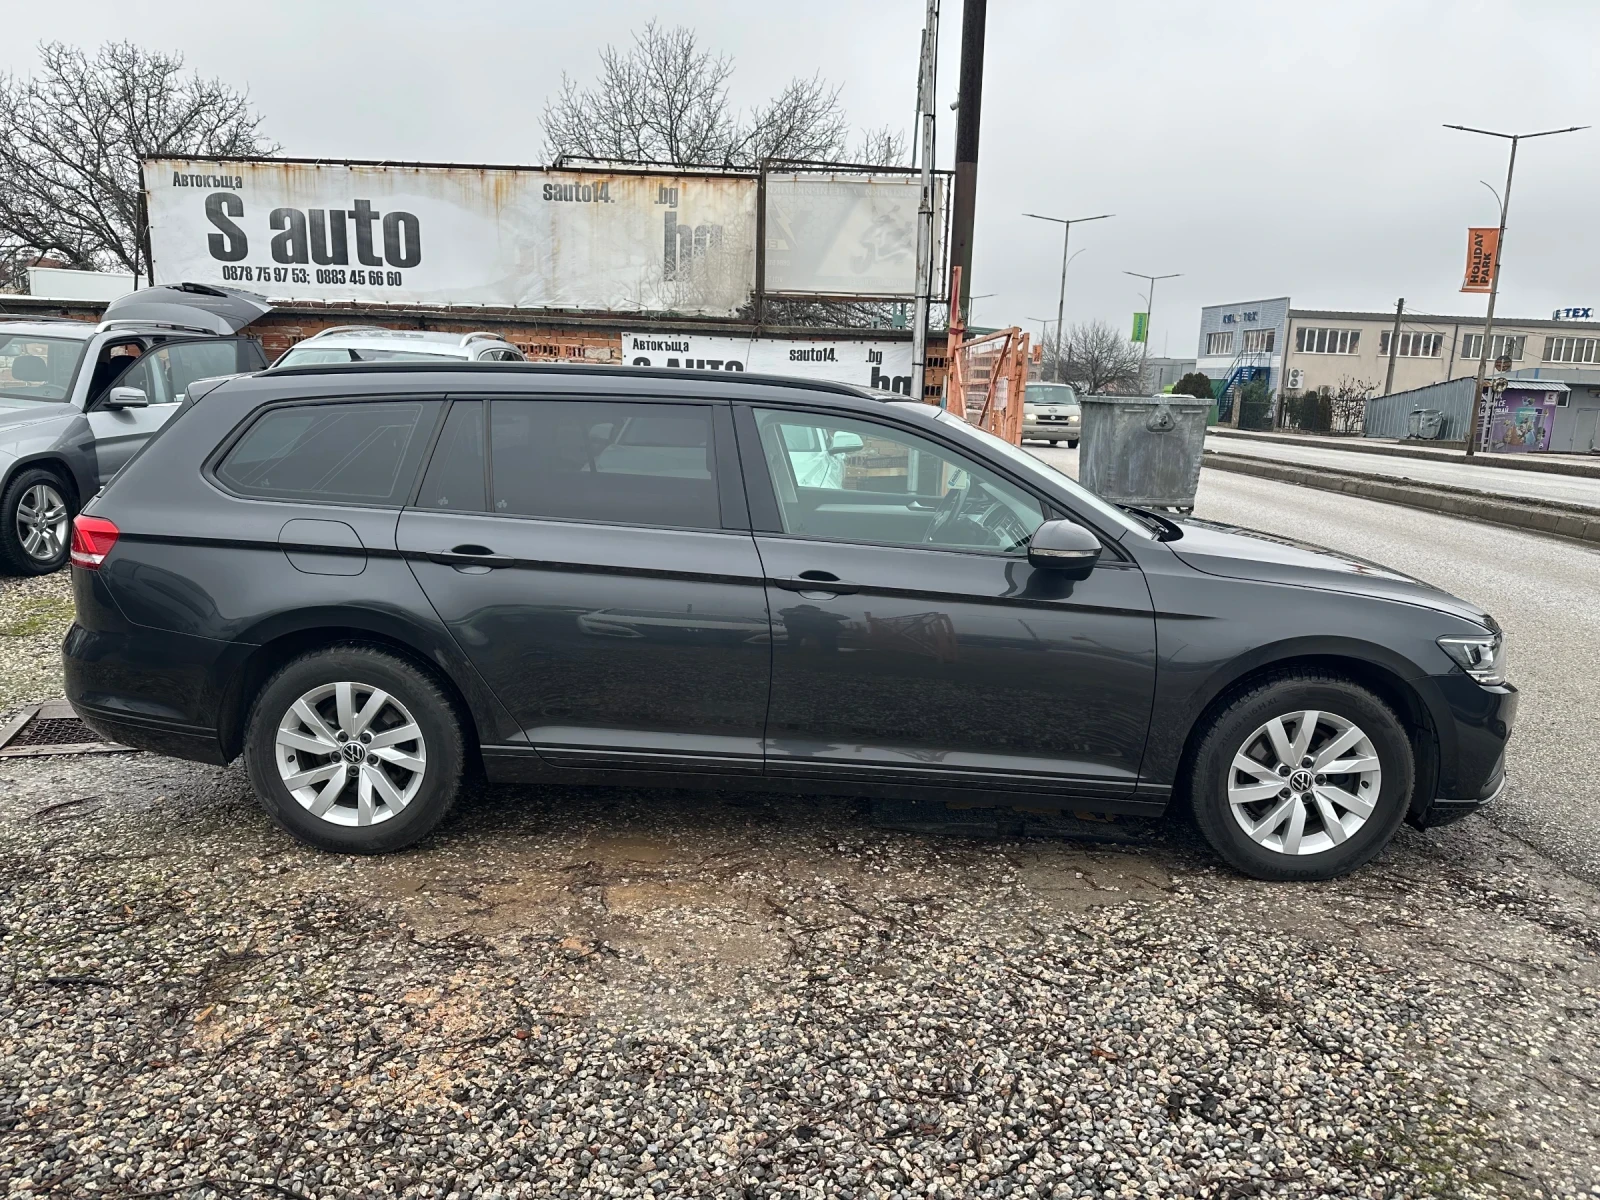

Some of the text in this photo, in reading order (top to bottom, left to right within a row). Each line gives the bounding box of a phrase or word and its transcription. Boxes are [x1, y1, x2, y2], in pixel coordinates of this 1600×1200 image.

[172, 171, 243, 190] Автокъща
[543, 181, 615, 203] sauto14.
[204, 192, 422, 268] S auto
[1470, 231, 1484, 283] HOLIDAY
[222, 265, 402, 287] 0878 75 97 53; 0883 45 66 60
[1480, 253, 1492, 284] PARK
[1564, 307, 1592, 318] TEX
[632, 338, 689, 353] Автокъща
[789, 347, 839, 362] sauto14.
[865, 348, 883, 365] .bg
